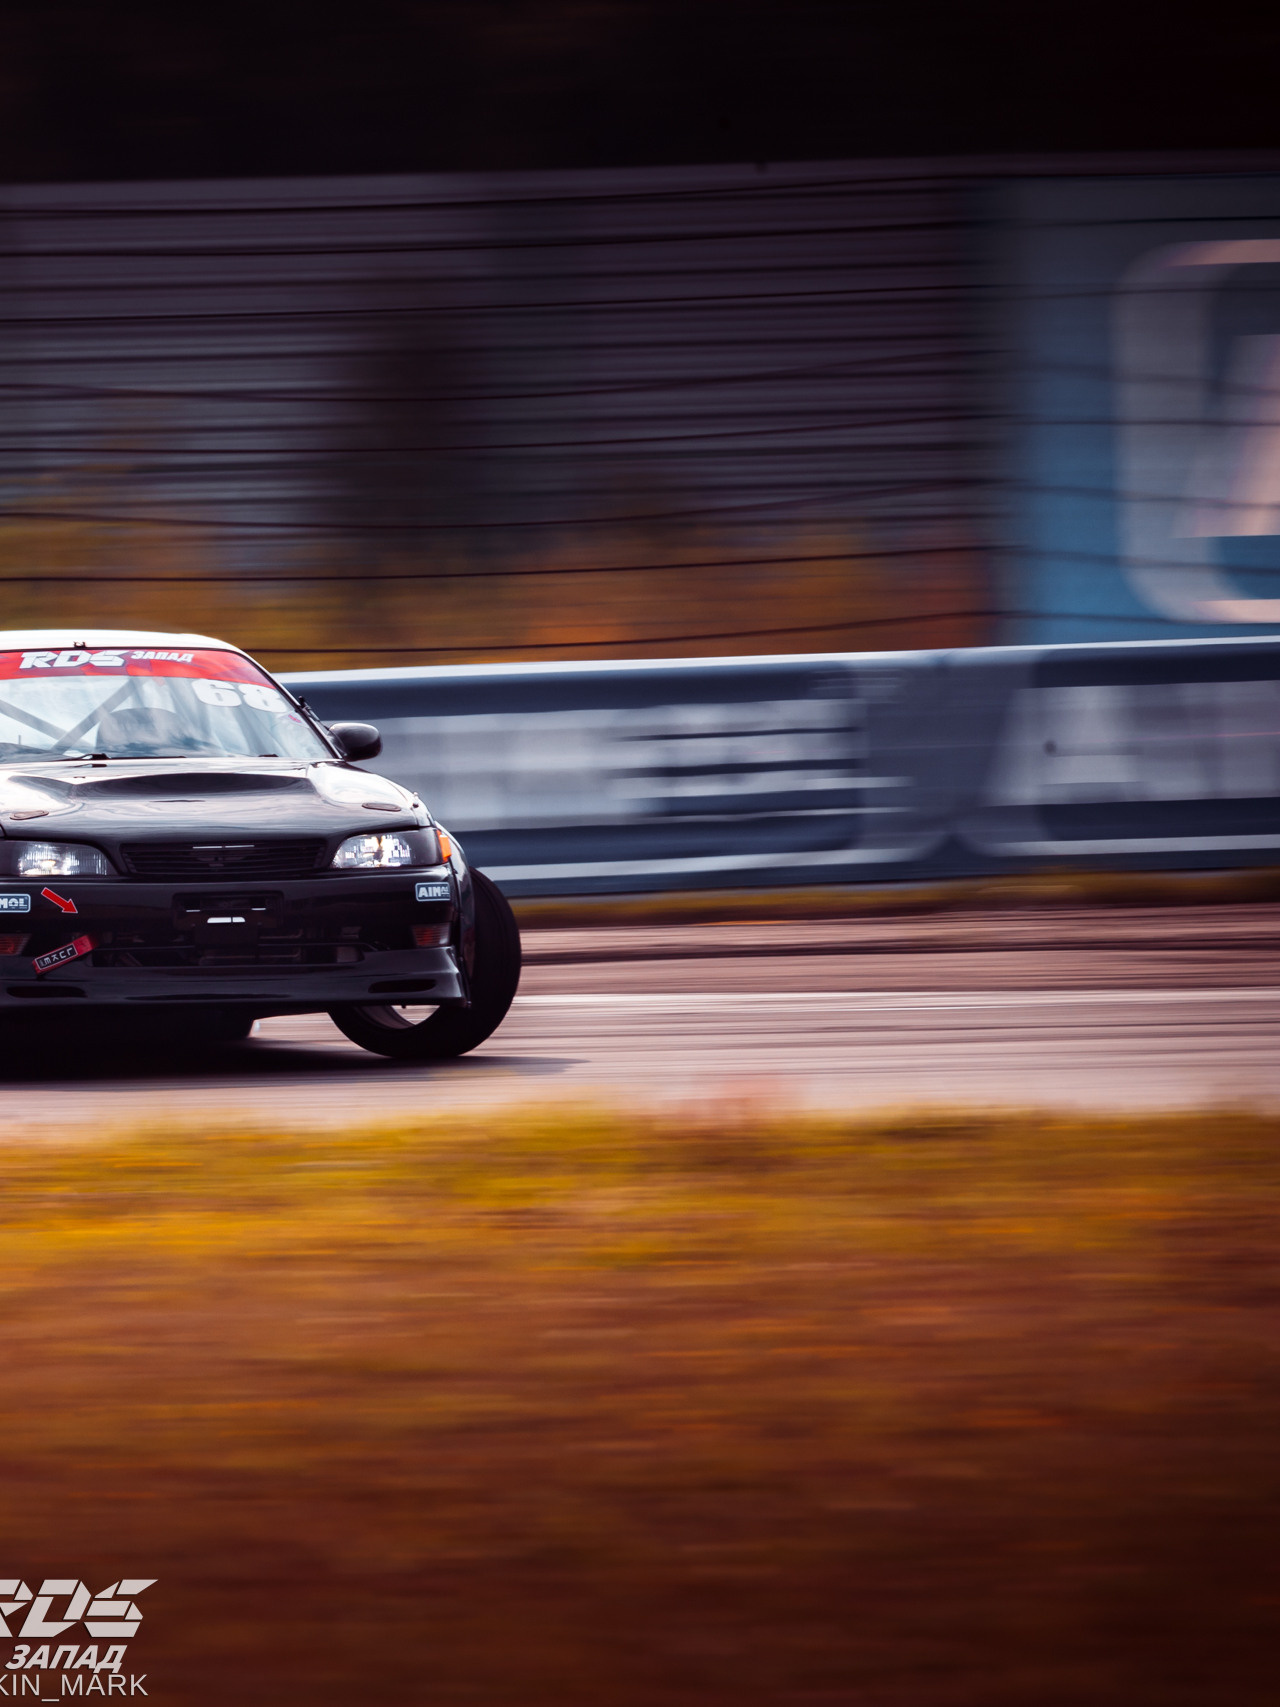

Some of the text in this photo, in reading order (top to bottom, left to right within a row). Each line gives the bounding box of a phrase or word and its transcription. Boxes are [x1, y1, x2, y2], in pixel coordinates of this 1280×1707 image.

[19, 650, 130, 669] RDS
[131, 651, 194, 663] ЗАПАД
[191, 678, 287, 713] 68
